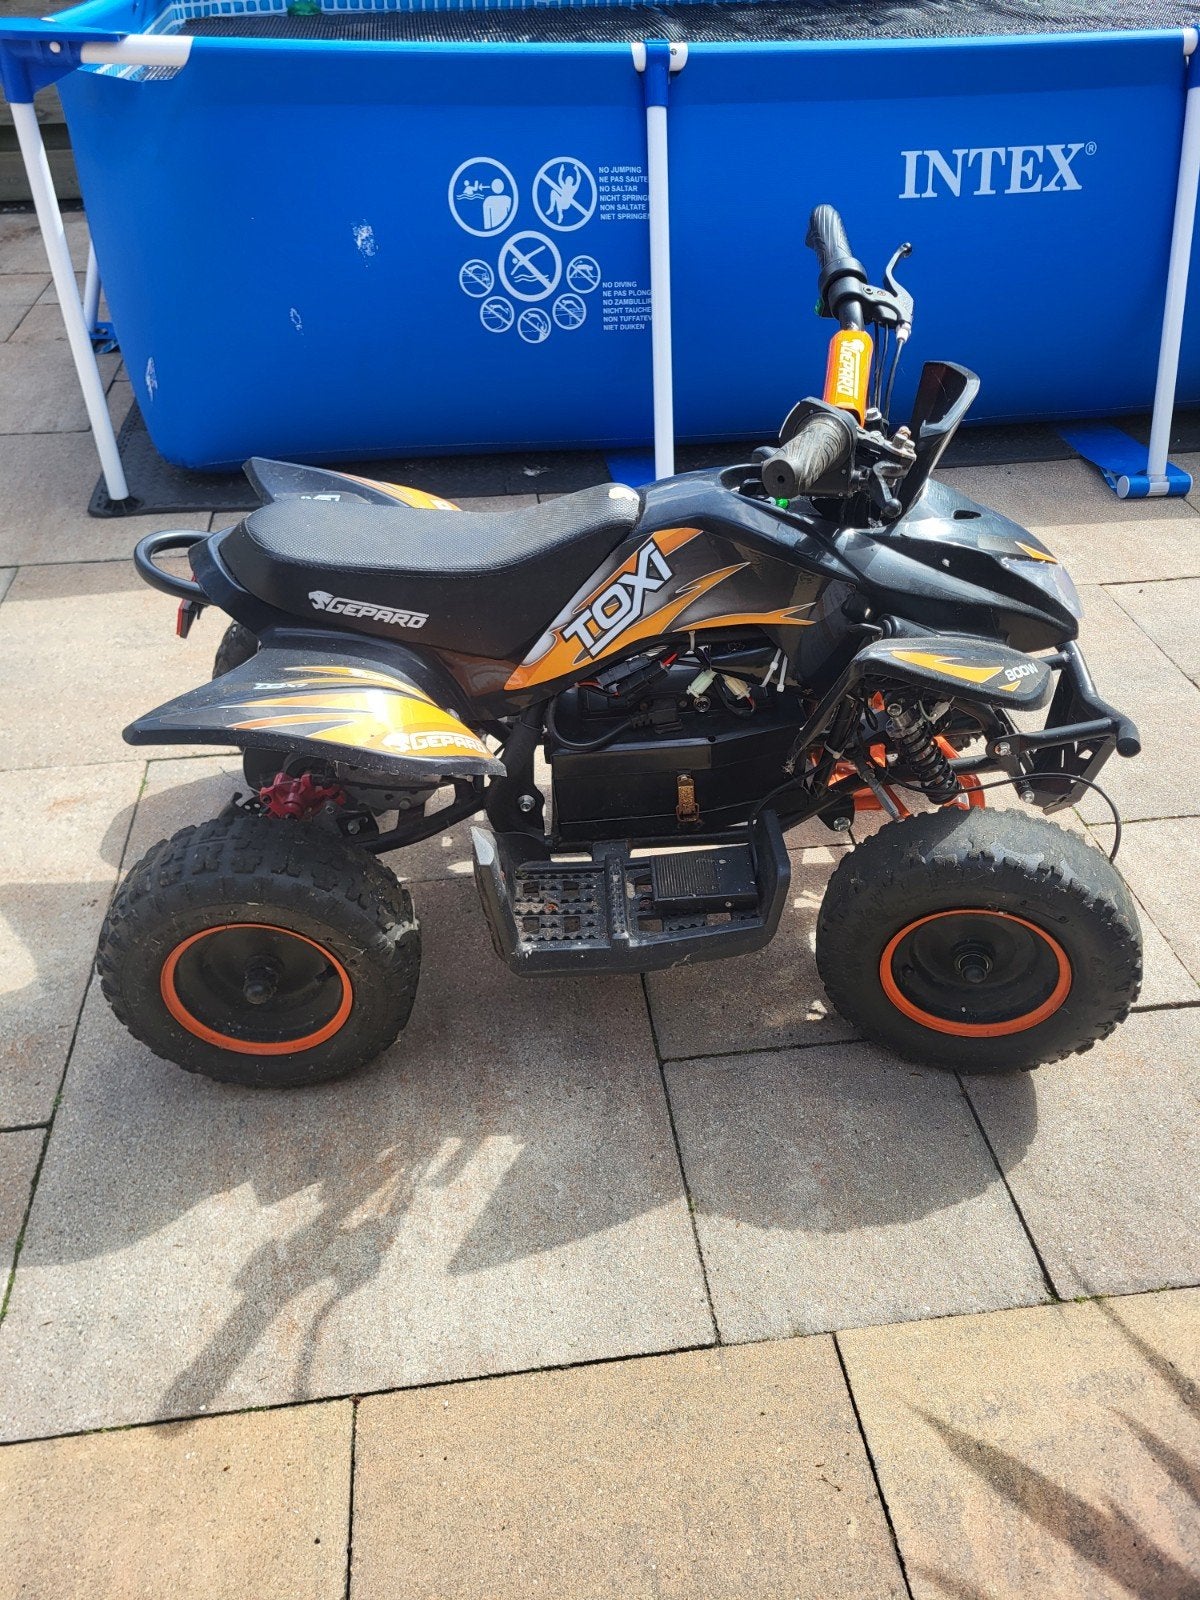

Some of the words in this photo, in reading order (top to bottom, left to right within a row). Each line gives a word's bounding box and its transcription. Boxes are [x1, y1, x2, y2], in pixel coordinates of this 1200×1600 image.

[610, 175, 624, 183] PAS
[625, 175, 648, 183] SAUTE
[600, 194, 621, 202] NICHT
[621, 194, 650, 202] SPRING
[616, 203, 646, 211] SALTATE
[619, 314, 652, 322] TUFFATEV
[562, 540, 673, 658] TOXI
[325, 597, 430, 629] GEPARD
[1004, 662, 1039, 682] 800W
